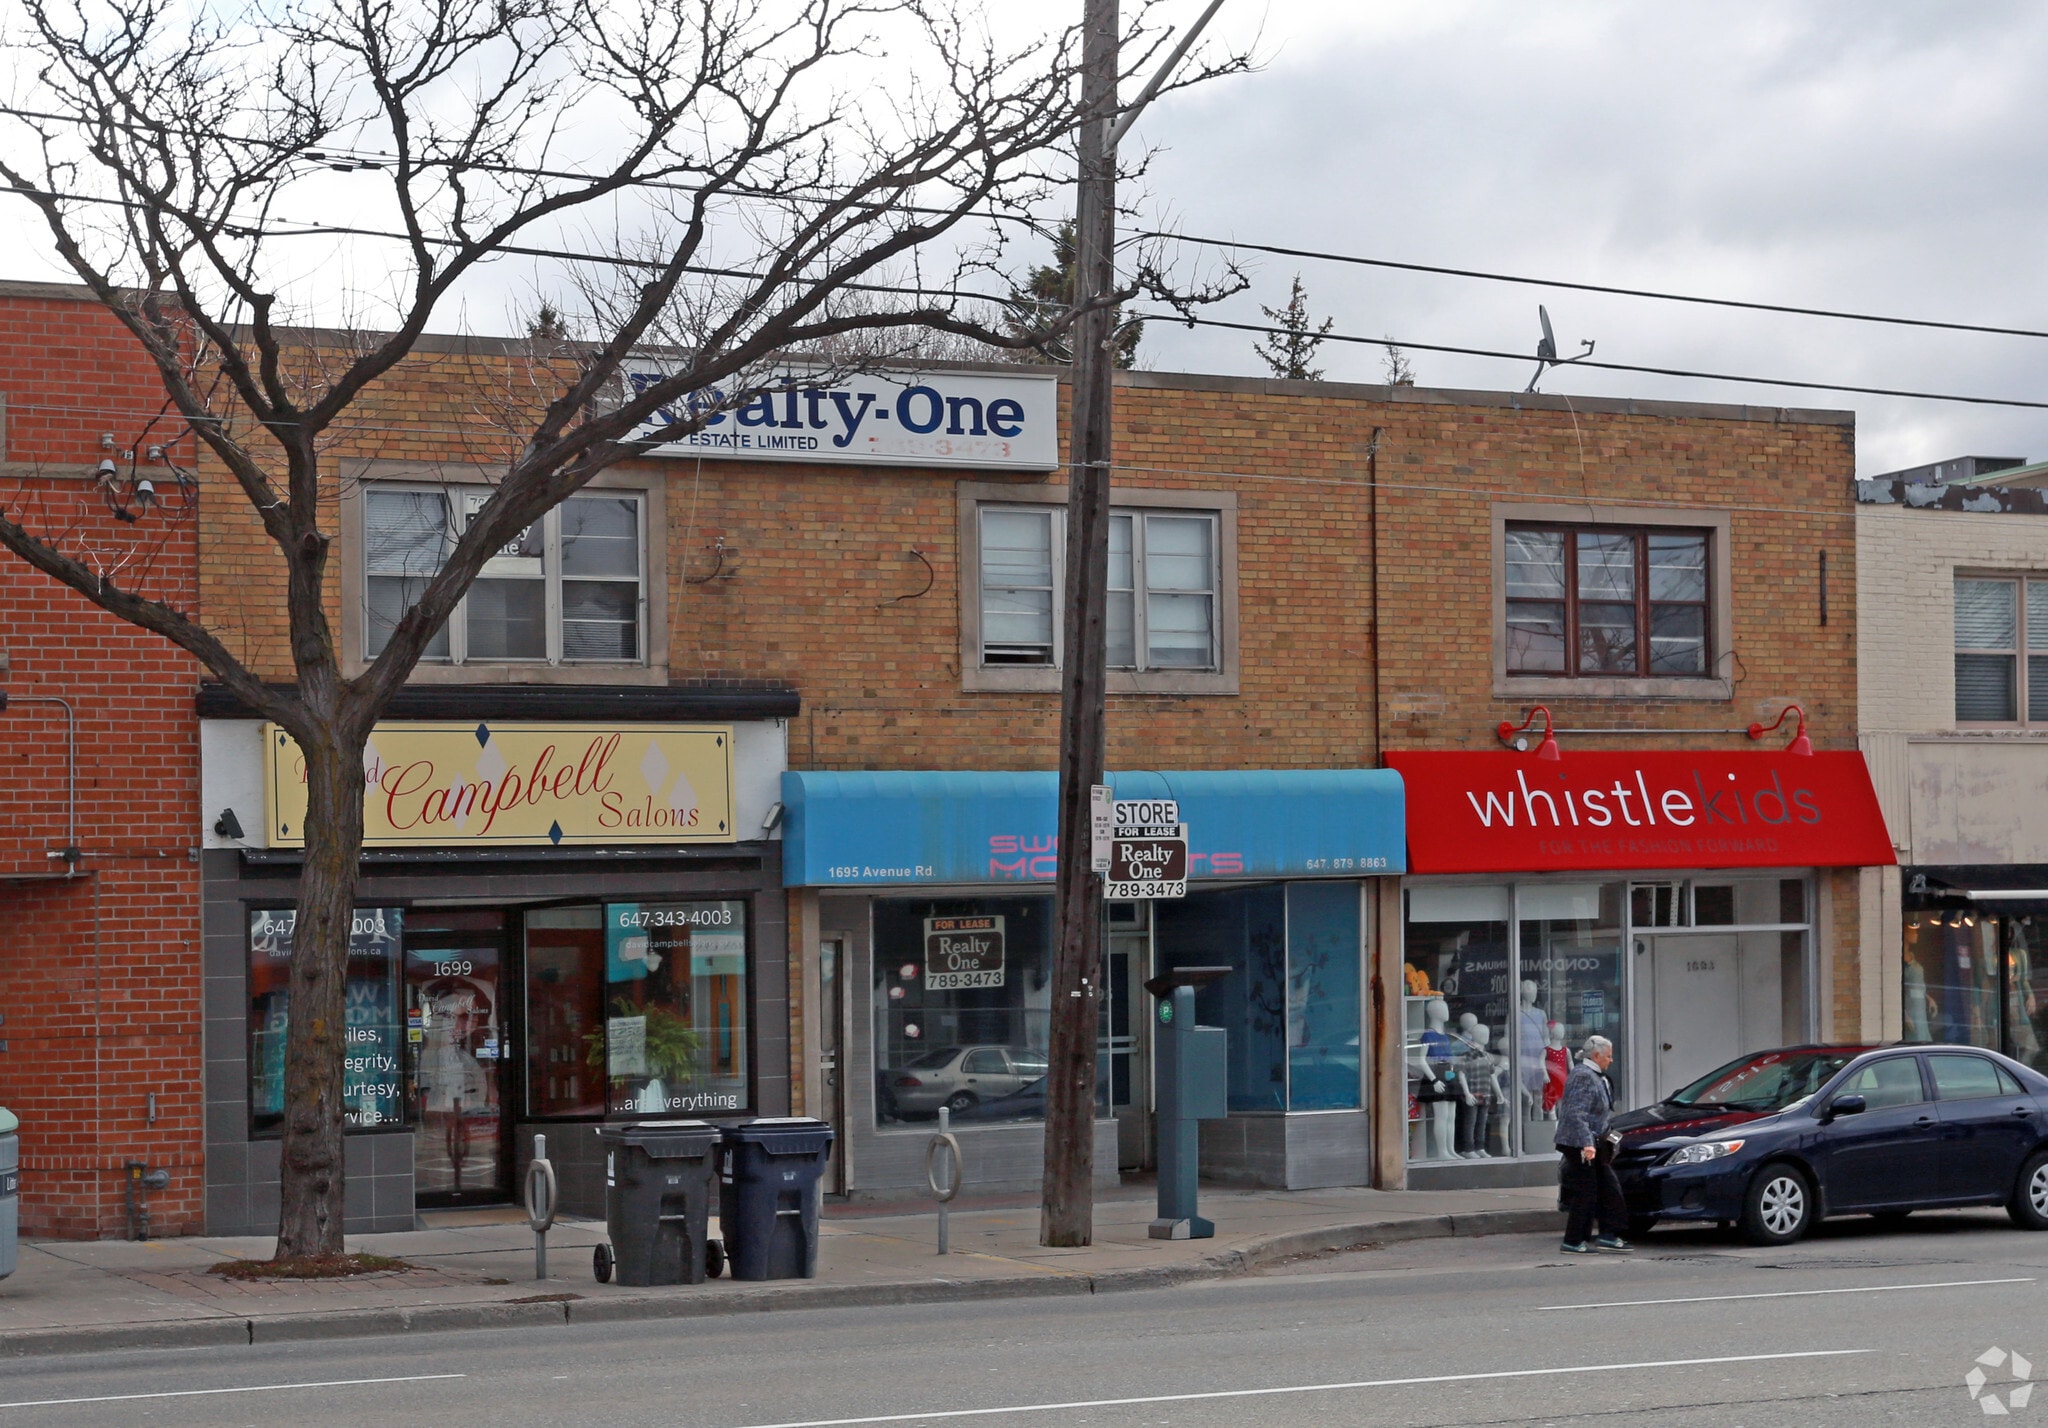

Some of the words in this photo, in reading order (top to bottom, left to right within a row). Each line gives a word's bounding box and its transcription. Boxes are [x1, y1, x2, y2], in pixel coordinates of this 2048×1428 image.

[689, 433, 751, 448] ESTATE
[757, 435, 818, 450] LIMITED
[380, 732, 621, 836] Campbell
[1466, 769, 1822, 827] whistlekids
[598, 791, 699, 828] Salons
[1116, 802, 1175, 824] STORE
[1118, 827, 1139, 837] FOR
[1144, 826, 1176, 837] LEASE
[1120, 843, 1174, 865] Realty
[1580, 840, 1614, 855] THE
[1128, 861, 1162, 879] One
[1359, 857, 1387, 868] 8863
[828, 866, 859, 878] 1695
[862, 865, 911, 878] Avenue
[915, 865, 937, 877] Rd.
[1108, 882, 1184, 897] 789-3473
[935, 920, 955, 930] FOR
[960, 919, 991, 929] LEASE
[938, 935, 992, 956] Realty
[434, 961, 472, 976] 1699
[947, 953, 980, 970] One
[928, 972, 1002, 989] 789-3473
[664, 1092, 737, 1111] verything
